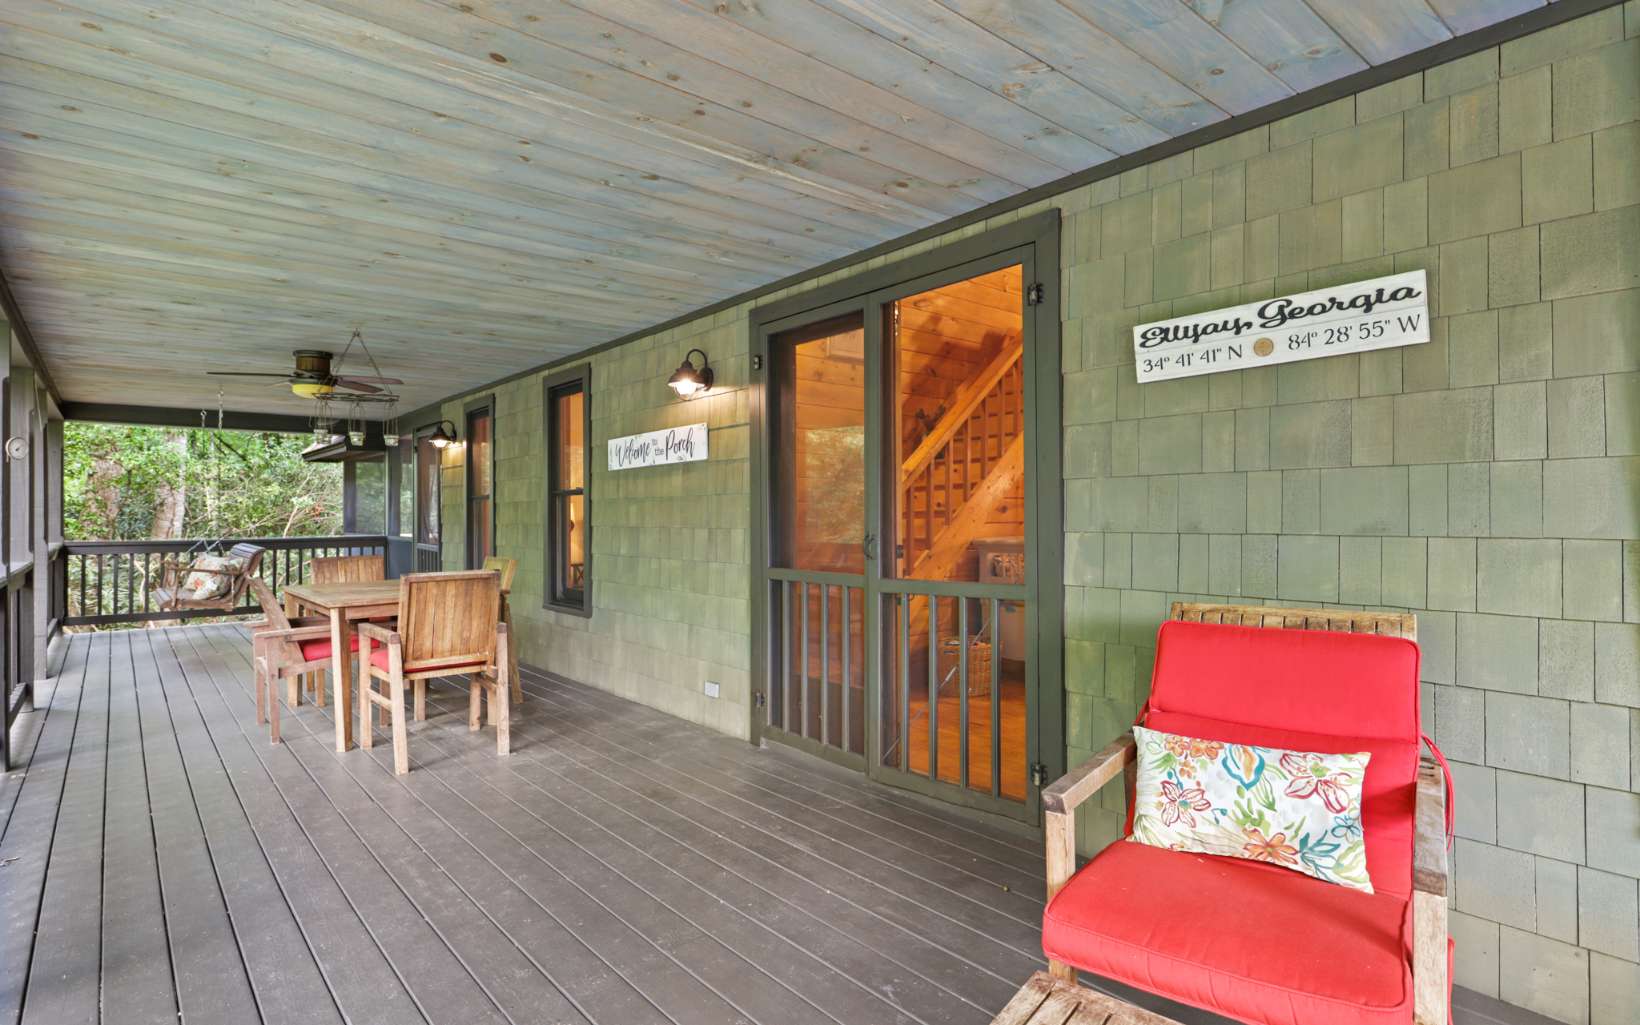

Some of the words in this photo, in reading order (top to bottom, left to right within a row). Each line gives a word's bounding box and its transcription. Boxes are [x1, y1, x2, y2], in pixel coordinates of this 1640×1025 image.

[1258, 286, 1422, 328] Georgia
[1175, 352, 1194, 368] 41'
[1228, 344, 1242, 360] N
[1324, 326, 1353, 345] 28'
[1359, 319, 1391, 340] 55"
[1397, 314, 1421, 333] W
[665, 427, 695, 461] Porch
